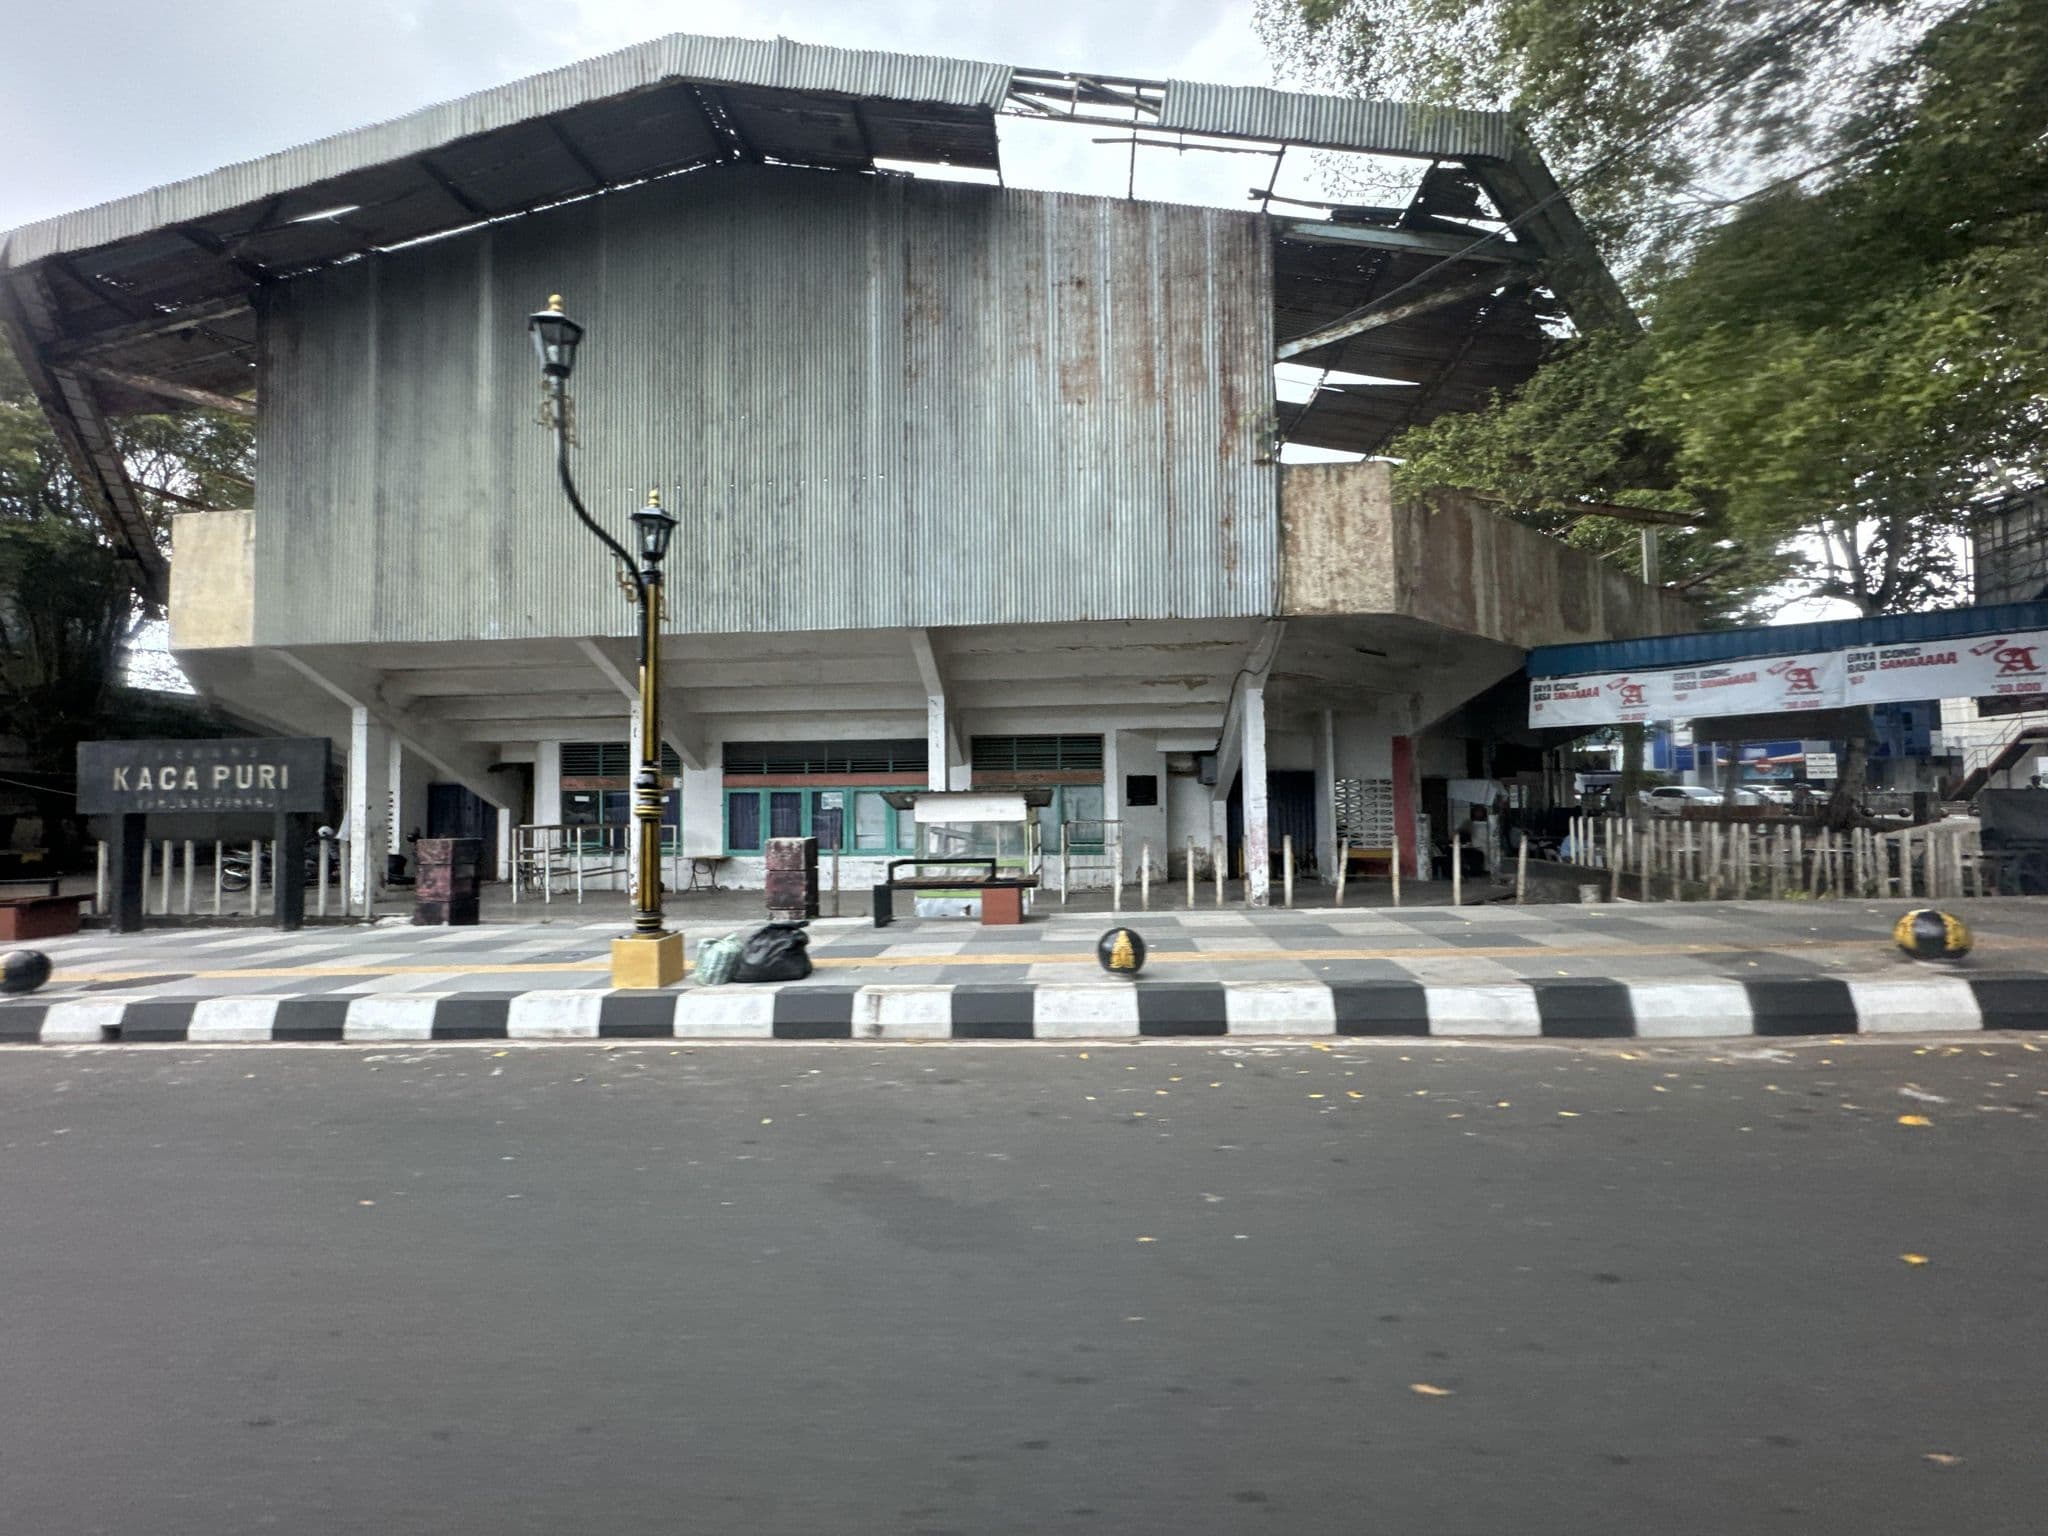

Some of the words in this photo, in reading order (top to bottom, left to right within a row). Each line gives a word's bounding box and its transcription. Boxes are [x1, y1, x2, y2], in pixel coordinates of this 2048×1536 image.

[1847, 652, 1876, 663] GAYA
[112, 766, 199, 791] KACA
[212, 765, 289, 790] PURI
